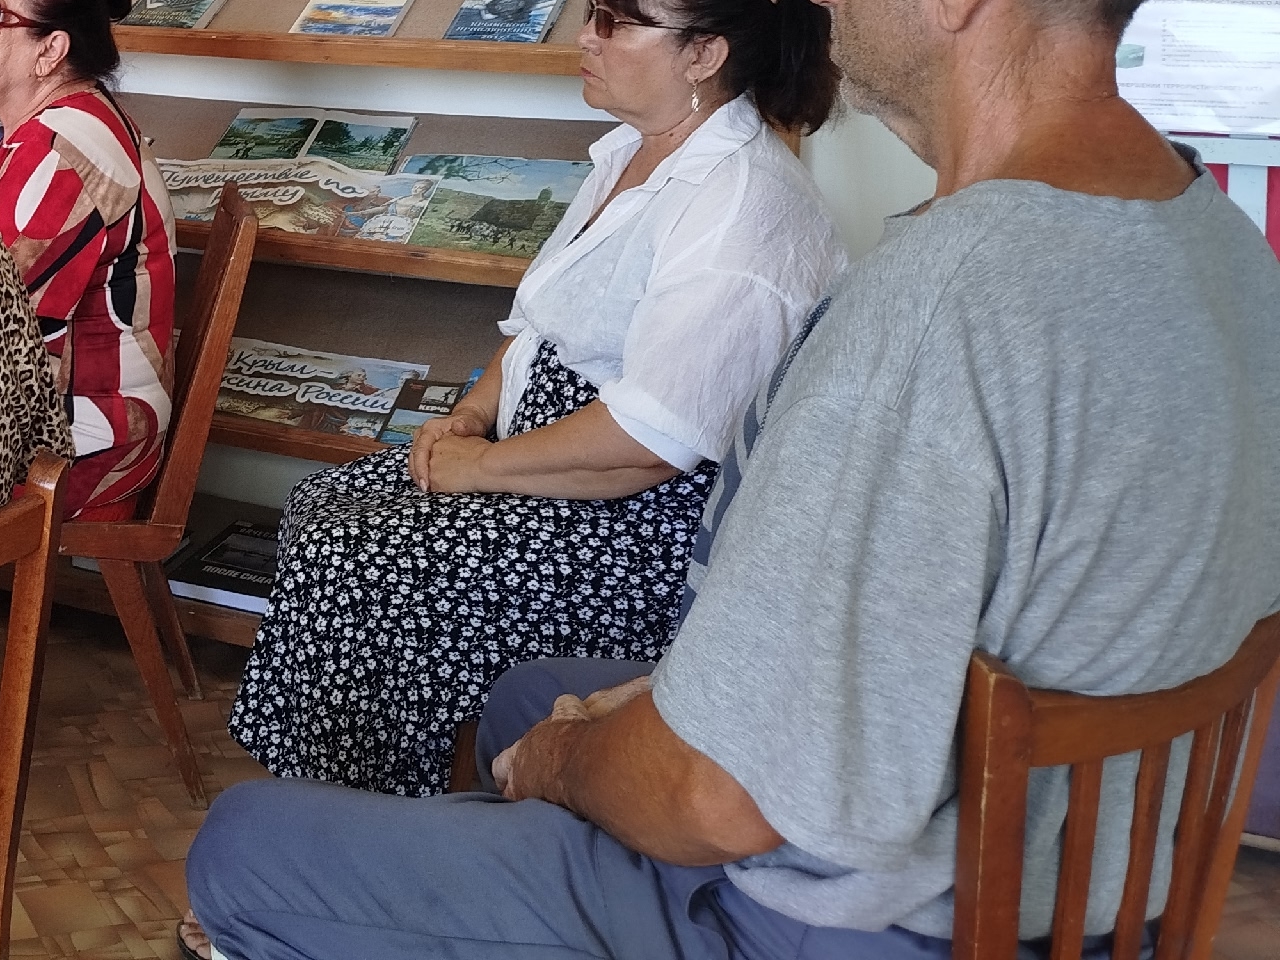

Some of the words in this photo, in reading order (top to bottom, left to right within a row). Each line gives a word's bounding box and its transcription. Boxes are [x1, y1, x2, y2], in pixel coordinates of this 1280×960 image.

[323, 177, 366, 195] по
[418, 404, 450, 413] КЕРЧЬ
[201, 565, 242, 578] ПОСЛЕ
